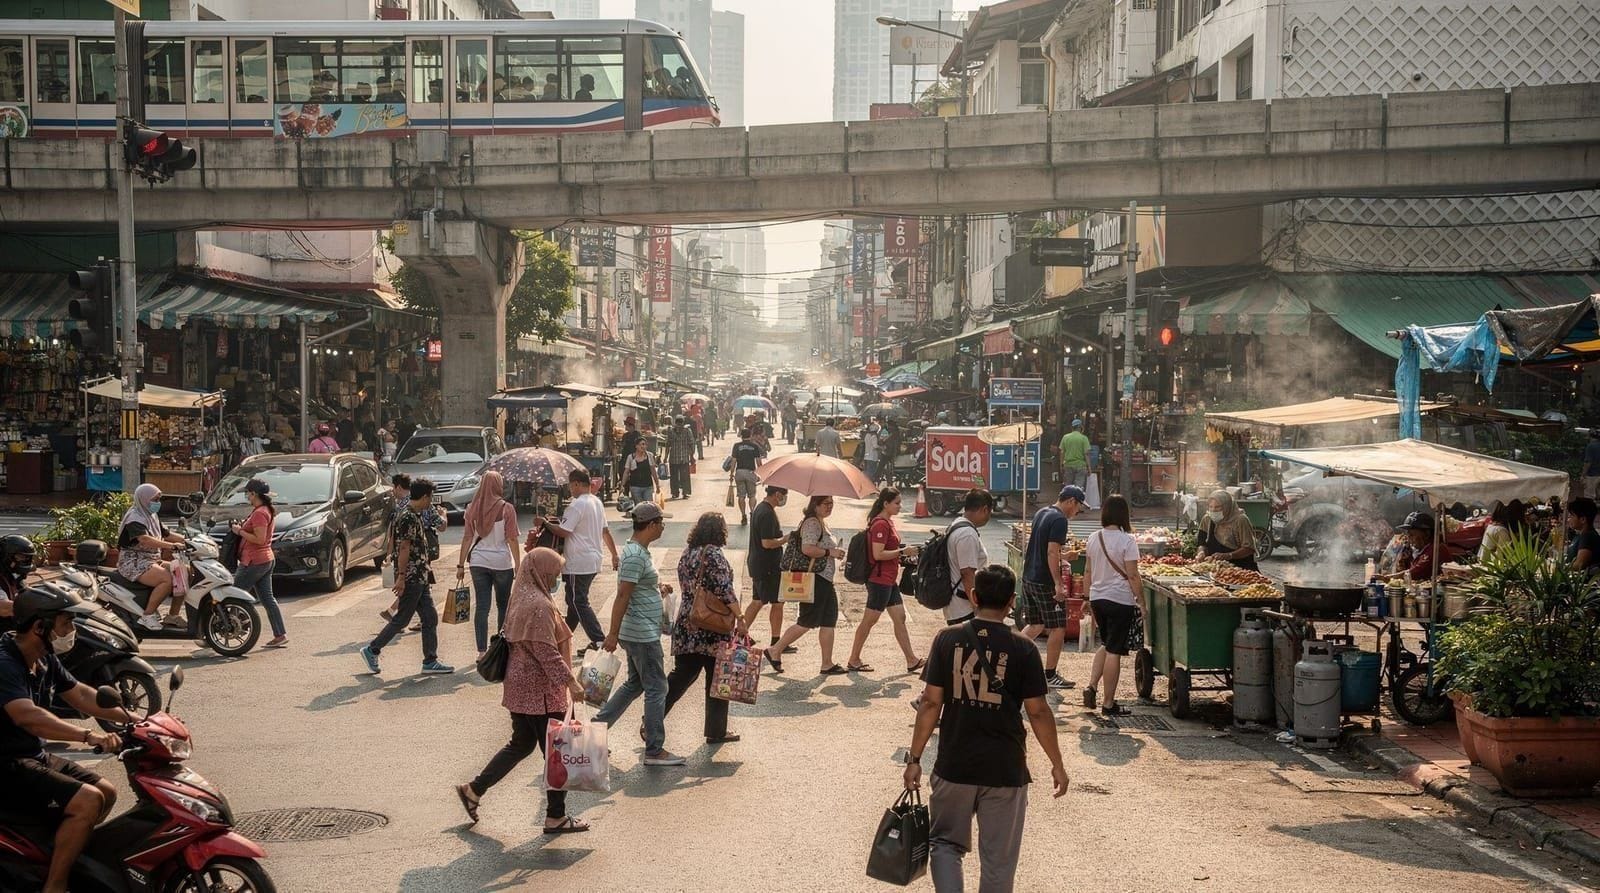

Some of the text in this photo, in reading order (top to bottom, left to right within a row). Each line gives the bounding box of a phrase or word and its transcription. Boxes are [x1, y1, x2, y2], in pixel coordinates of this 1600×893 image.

[931, 444, 982, 474] Soda
[953, 647, 1002, 703] KL
[562, 753, 591, 765] Soda
